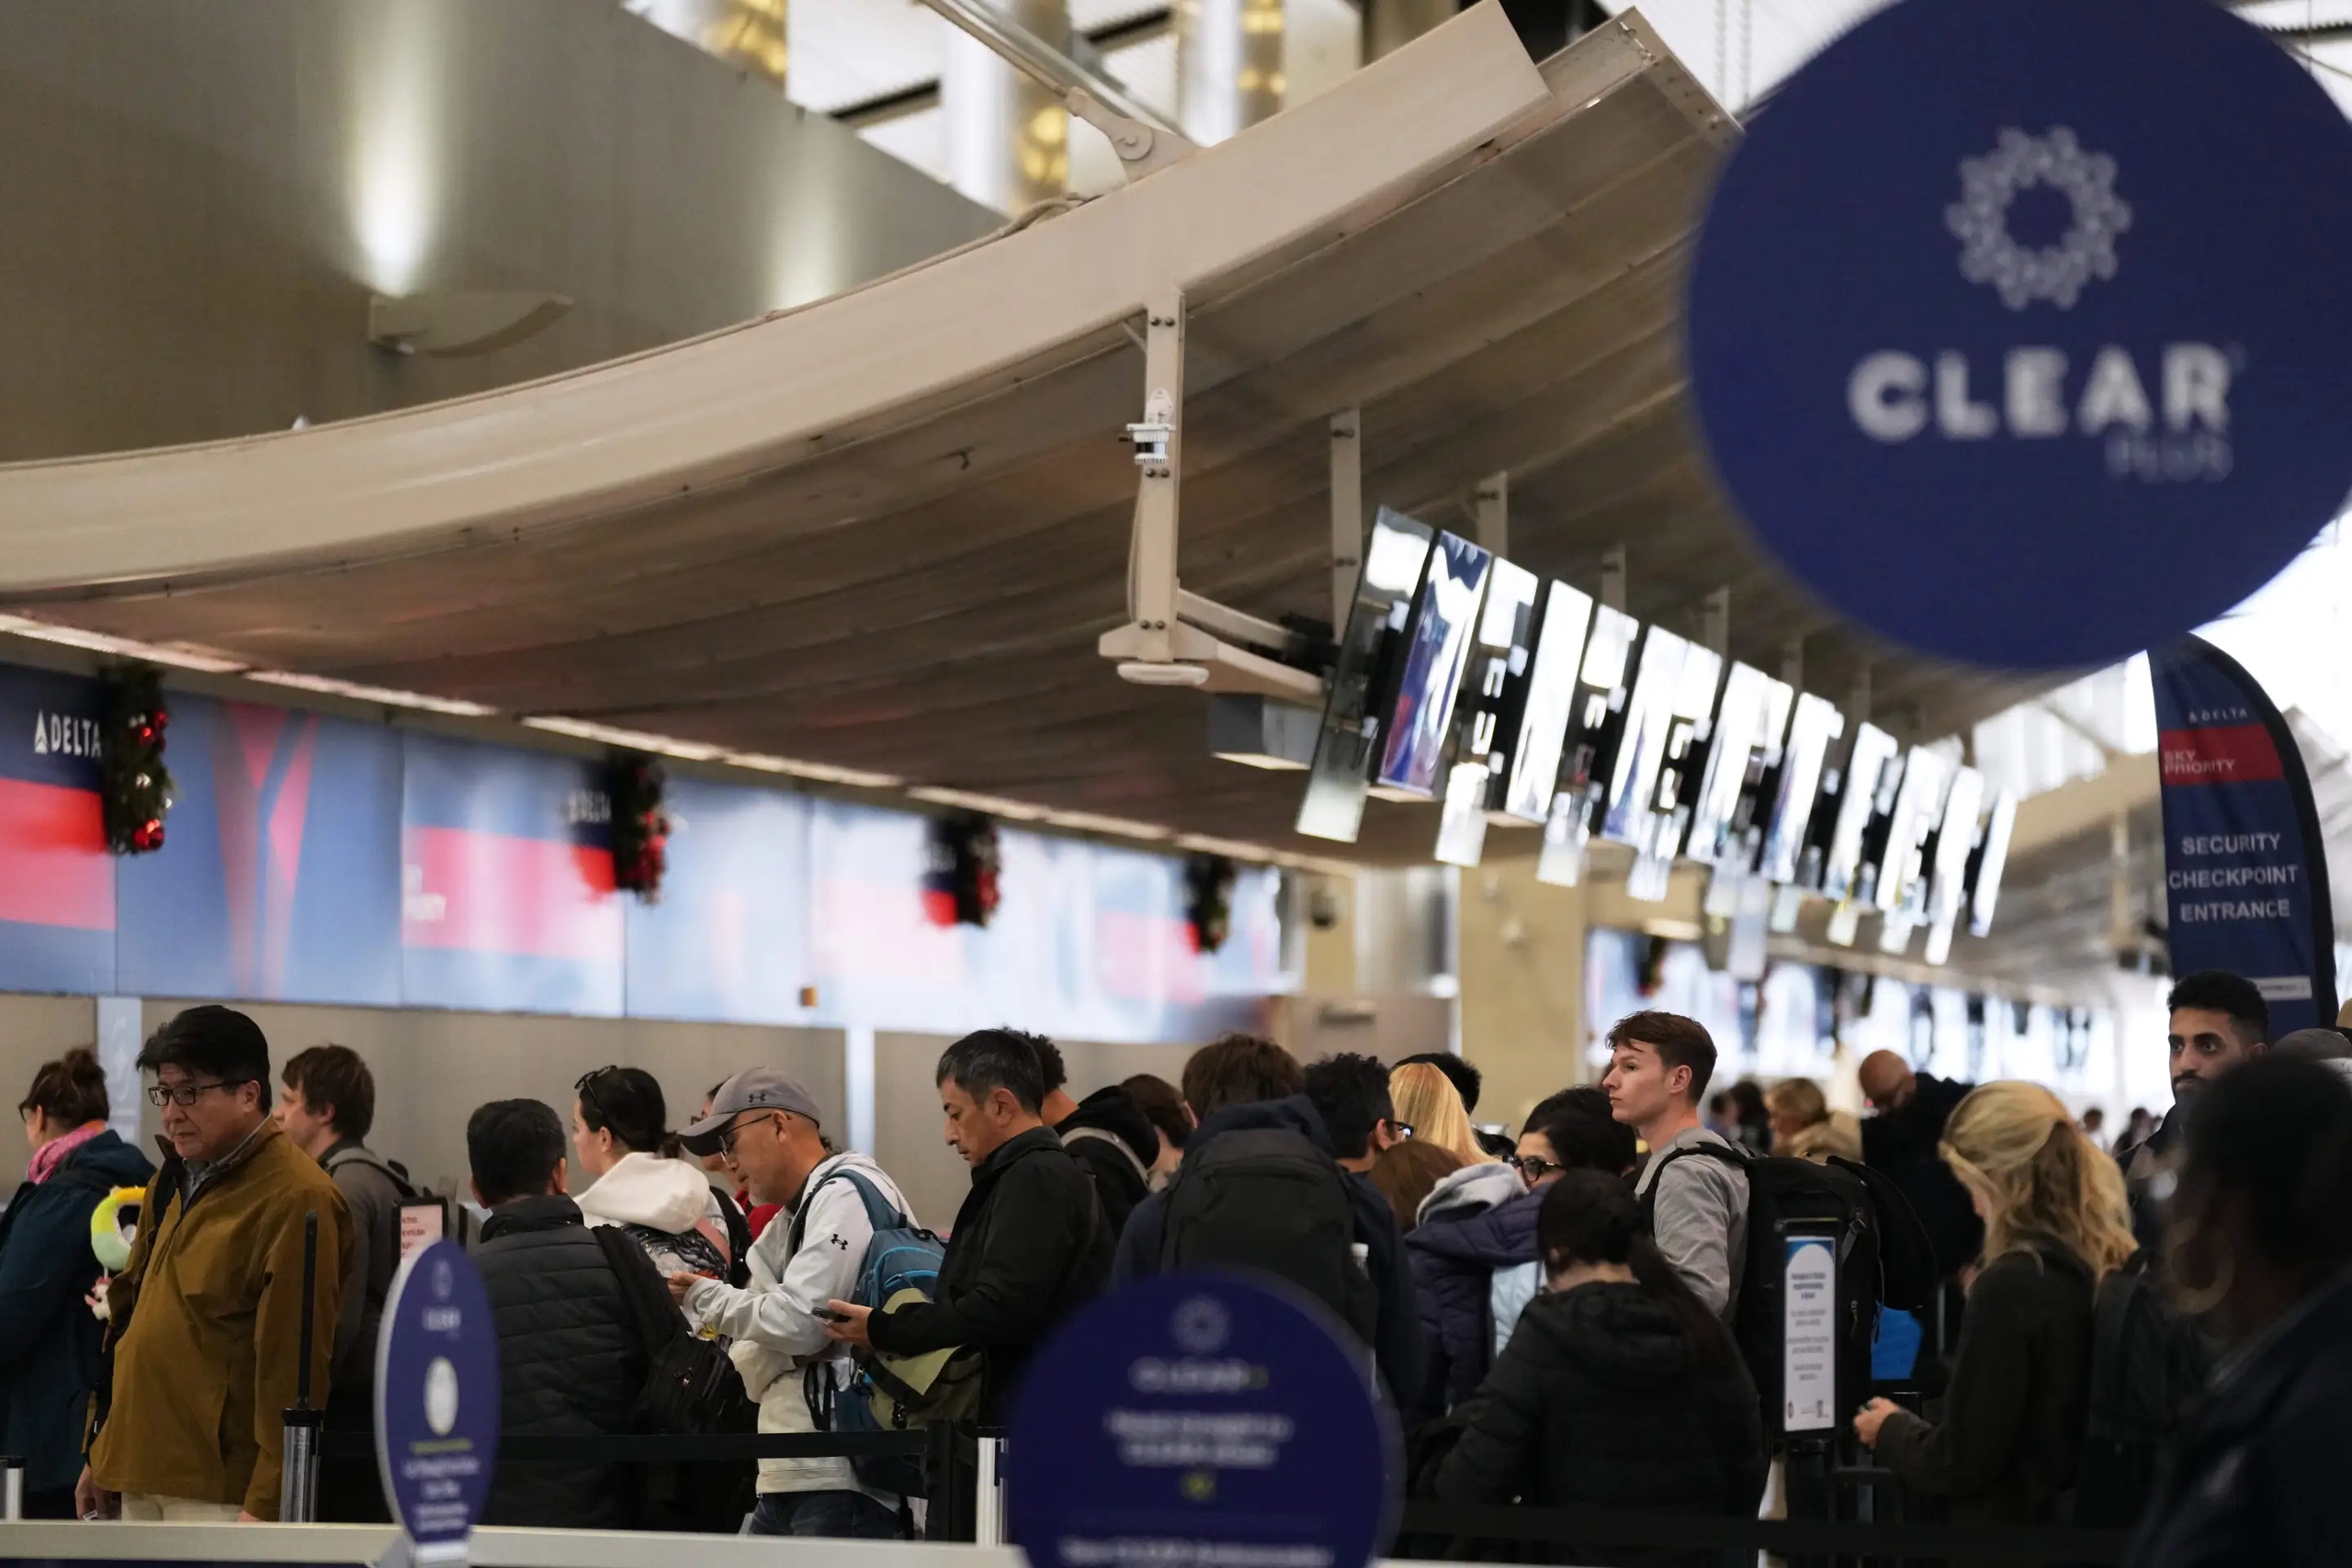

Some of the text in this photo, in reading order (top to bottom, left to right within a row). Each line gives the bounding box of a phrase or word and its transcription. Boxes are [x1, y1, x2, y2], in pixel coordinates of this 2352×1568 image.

[1848, 344, 2231, 443] CLEAR
[2201, 706, 2248, 722] DELTA
[50, 713, 102, 757] DELTA
[2164, 749, 2196, 762] SKY
[2164, 759, 2235, 775] PRIORITY
[2181, 832, 2280, 855] SECURITY
[2168, 863, 2298, 889] CHECKPOINT
[2180, 897, 2290, 922] ENTRANCE
